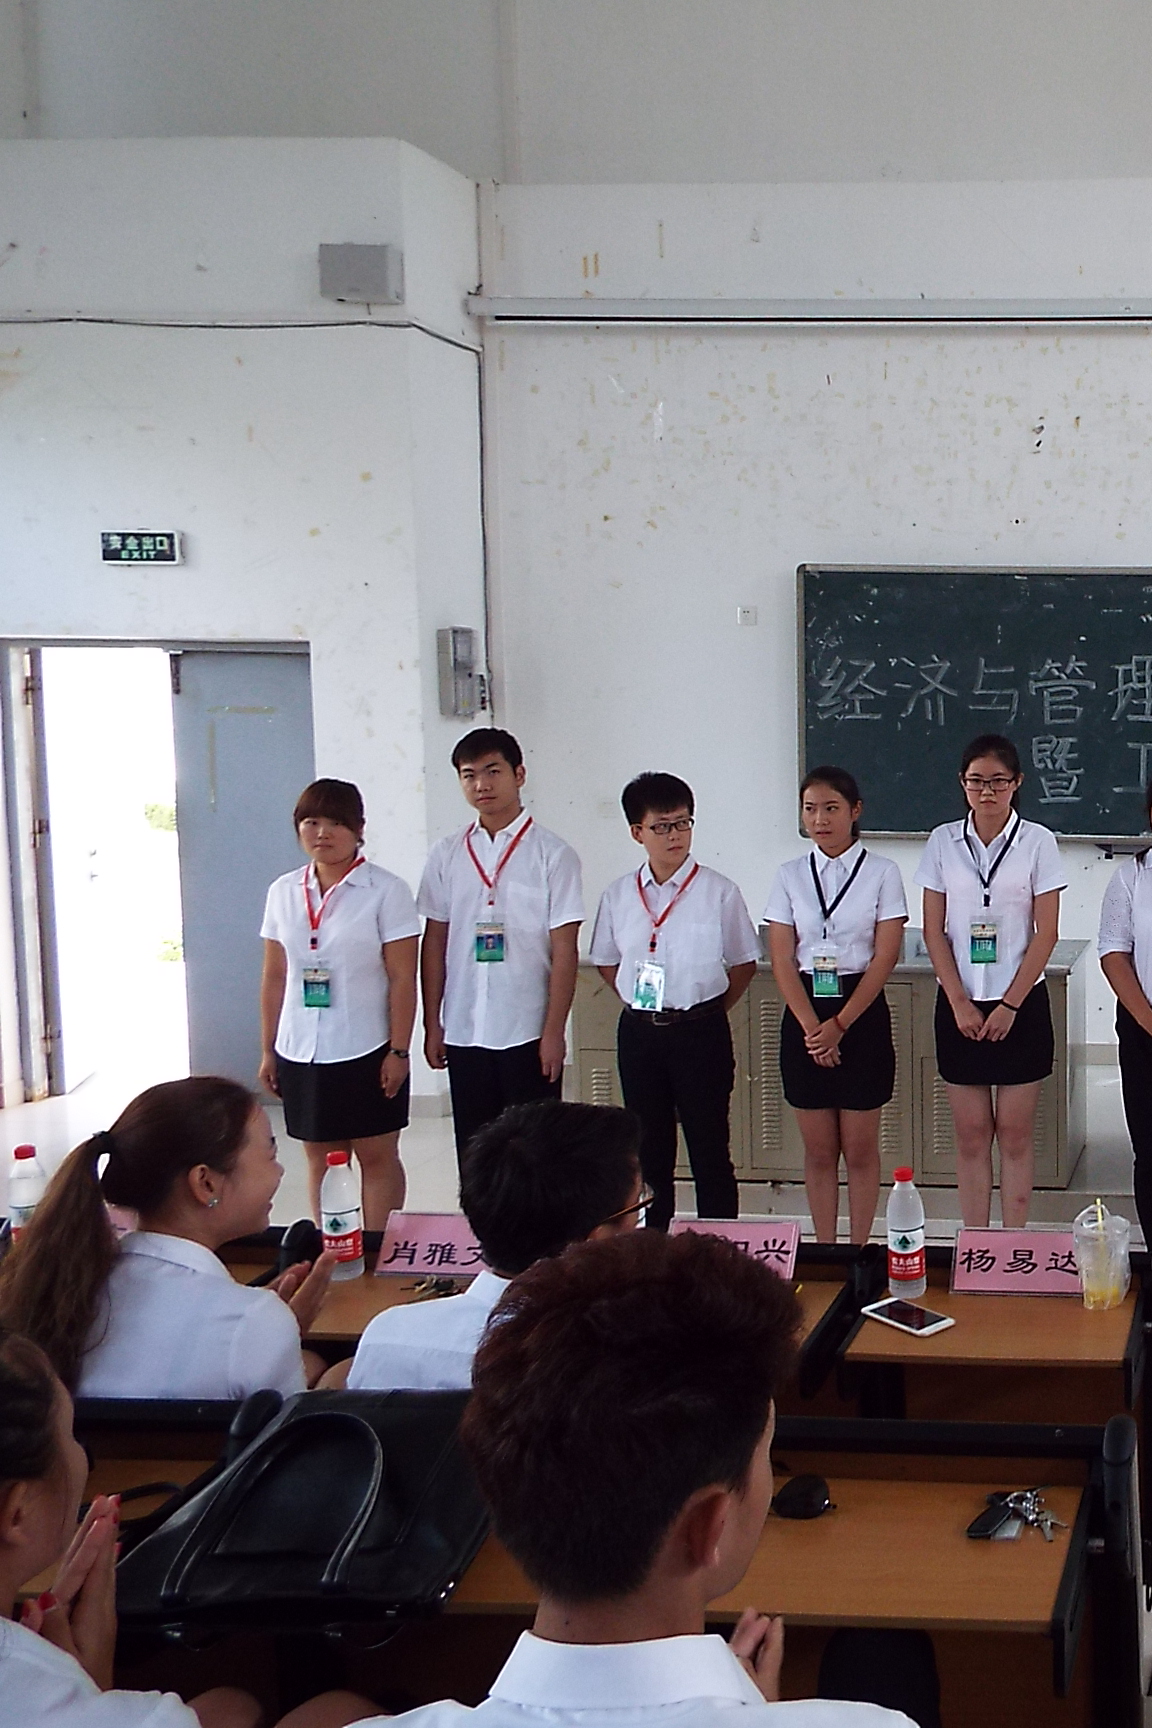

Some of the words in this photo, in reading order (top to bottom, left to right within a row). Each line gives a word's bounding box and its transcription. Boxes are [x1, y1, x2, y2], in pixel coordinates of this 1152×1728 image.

[121, 550, 156, 559] EXIT
[959, 1248, 1079, 1276] 杨易达
